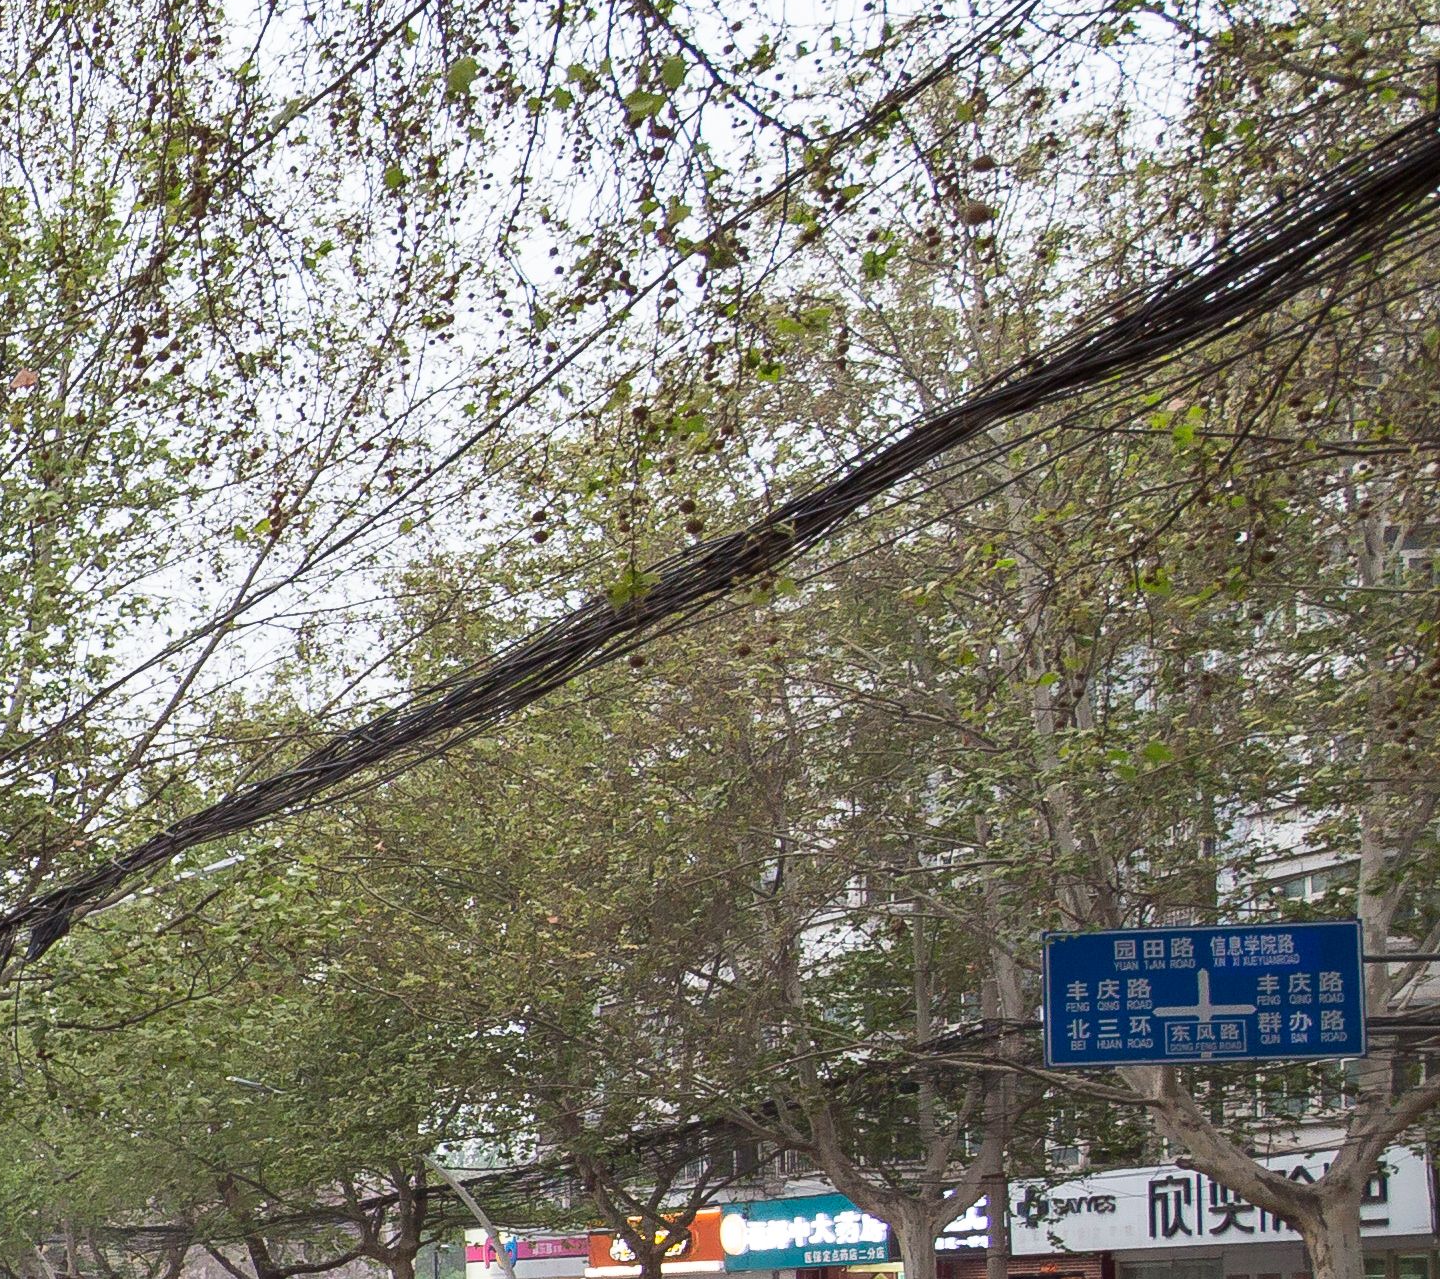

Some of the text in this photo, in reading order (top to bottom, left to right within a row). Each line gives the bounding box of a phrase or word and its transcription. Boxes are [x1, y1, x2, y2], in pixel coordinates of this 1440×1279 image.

[1114, 933, 1295, 960] 园田路 信息学院路
[1113, 961, 1139, 971] YUAN
[1170, 959, 1196, 969] ROAD
[1213, 957, 1226, 967] XIN
[1232, 956, 1240, 967] XI
[1066, 978, 1152, 1001] 丰庆路
[1257, 971, 1344, 995] 丰庆路
[1065, 1000, 1153, 1012] FENG QING ROAD
[1257, 993, 1345, 1006] FENG QING ROAD
[1066, 1016, 1152, 1040] 北三环
[1258, 1010, 1345, 1033] 群办路
[1171, 1024, 1240, 1042] 东风路
[1260, 1032, 1348, 1045] QUN BAN ROAD
[1071, 1039, 1154, 1051] BEI HUAN ROAD
[1170, 1041, 1242, 1052] DONG FENG ROAD
